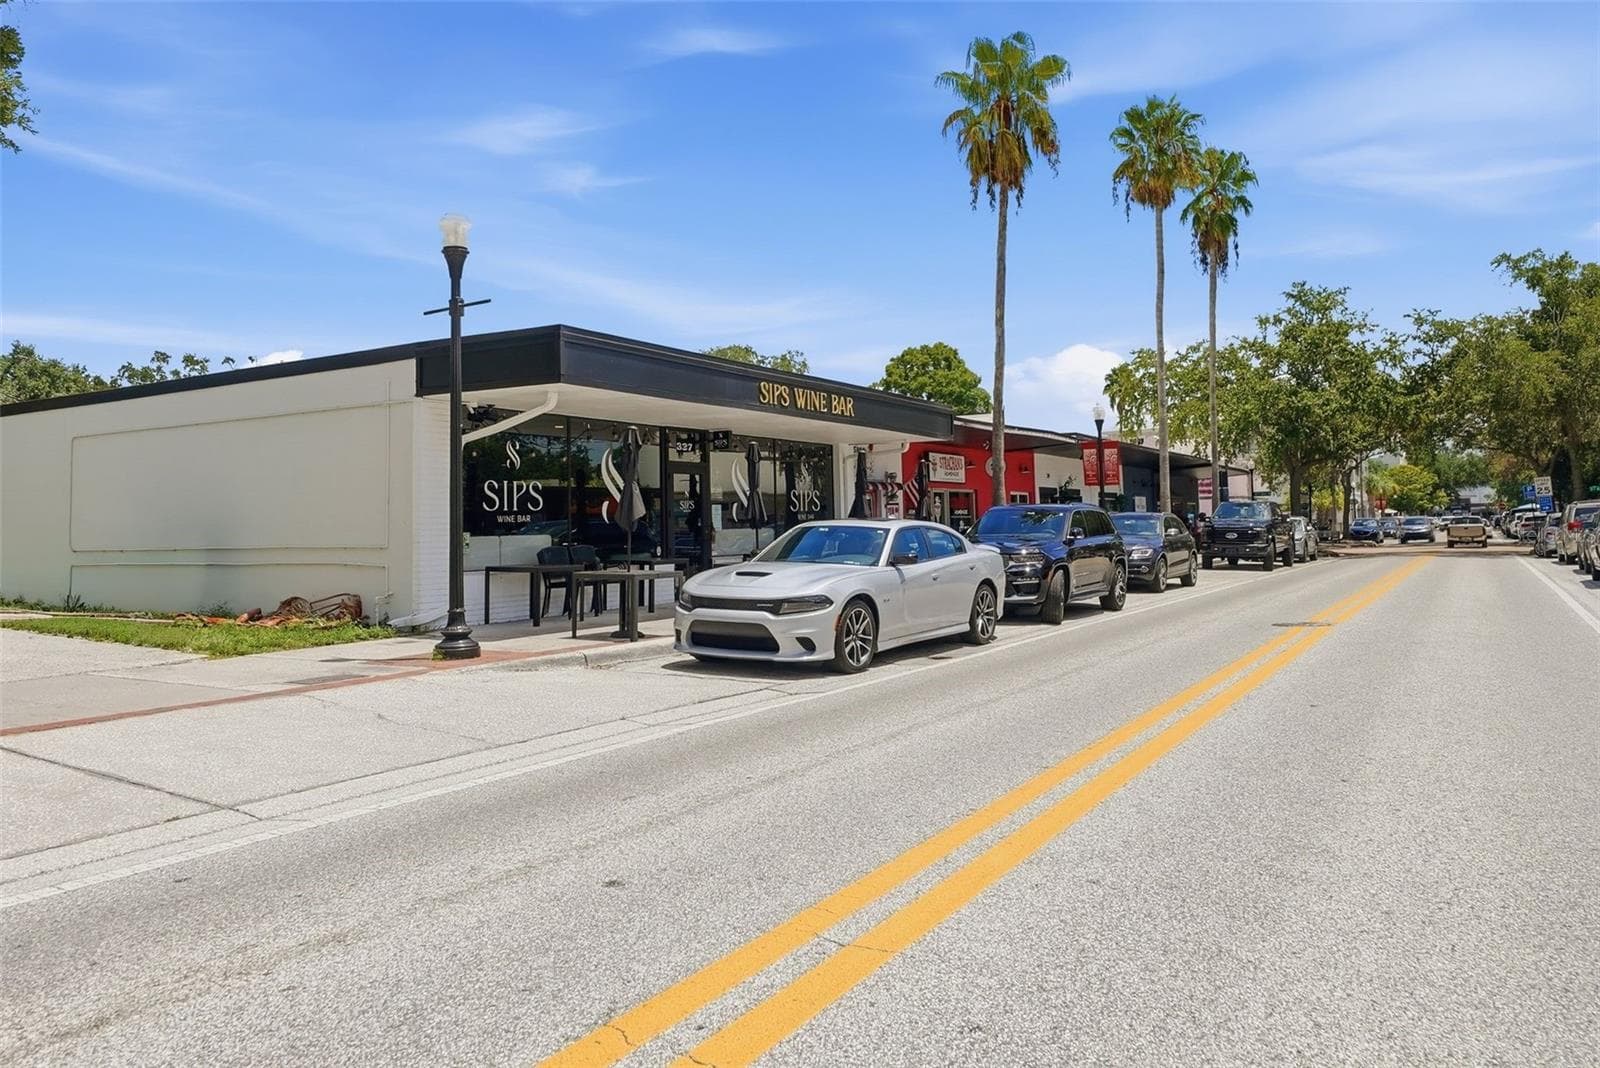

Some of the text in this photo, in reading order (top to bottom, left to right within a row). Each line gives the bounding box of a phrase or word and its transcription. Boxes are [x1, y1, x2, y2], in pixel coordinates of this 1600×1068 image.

[760, 381, 855, 417] SIPS WINE BAR
[676, 442, 693, 451] 327
[482, 479, 544, 512] SIPS
[1537, 487, 1551, 495] 25
[790, 489, 821, 512] SIPS
[496, 514, 531, 523] WINE BAR
